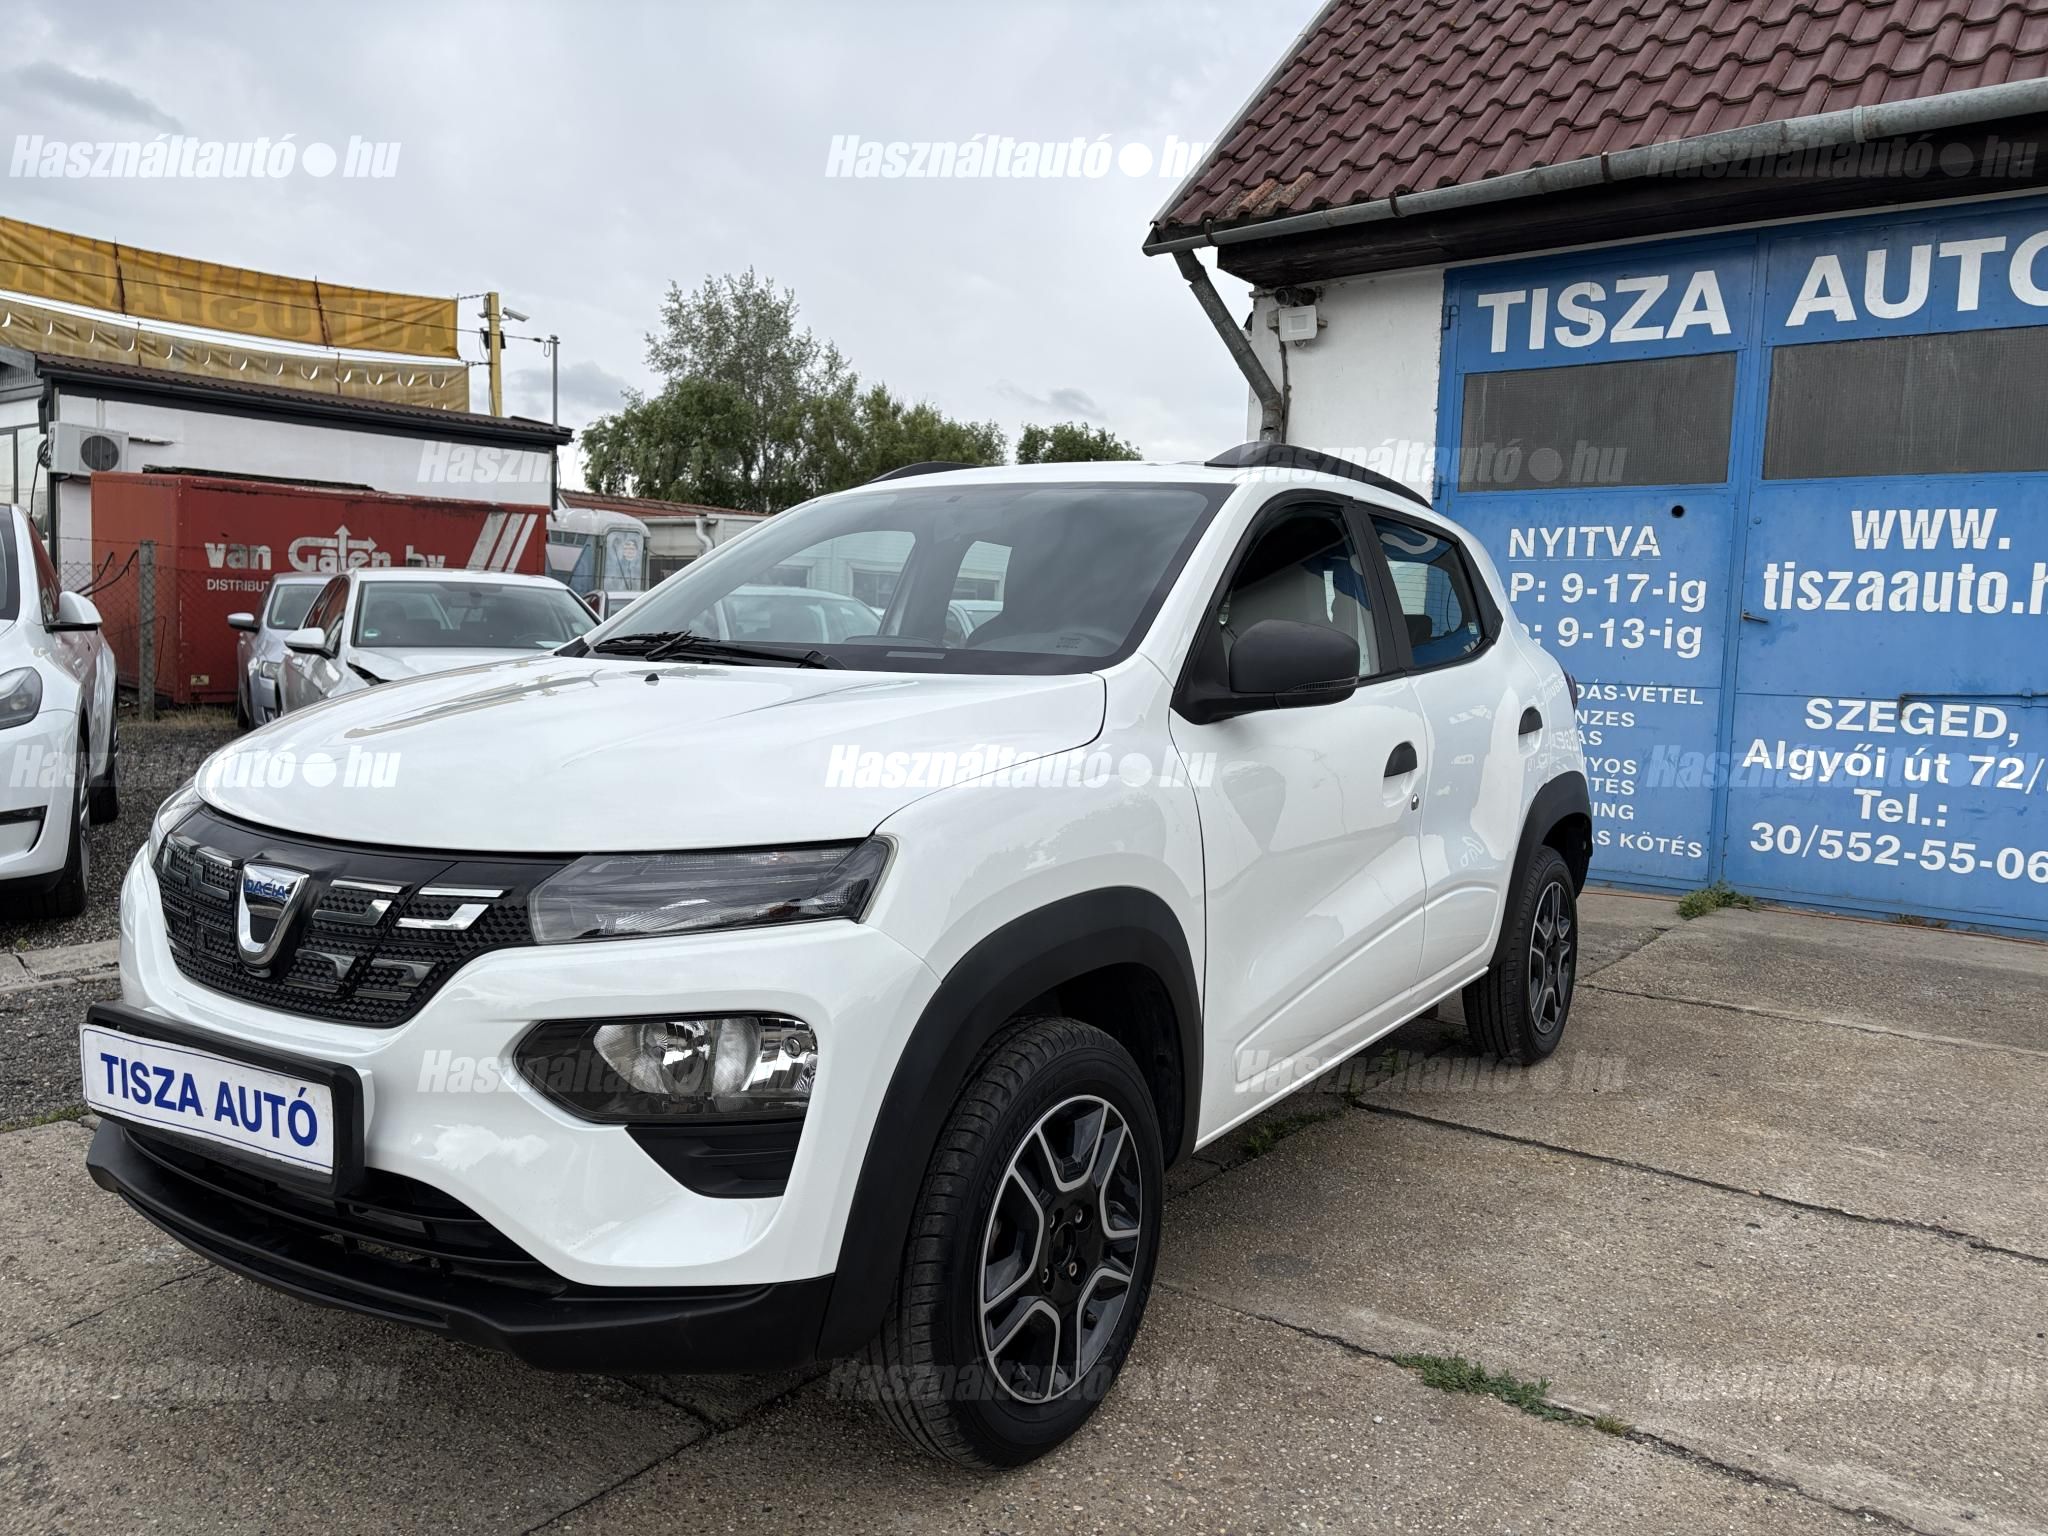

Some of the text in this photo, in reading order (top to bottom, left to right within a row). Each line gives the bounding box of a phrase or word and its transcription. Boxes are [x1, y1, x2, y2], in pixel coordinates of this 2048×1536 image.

[1477, 269, 1732, 353] TISZA
[1508, 525, 1662, 557] NYITVA
[1851, 508, 2011, 549] www.
[204, 542, 272, 571] van
[1561, 571, 1707, 613] 9-17-ig
[1557, 616, 1703, 659] 9-13-ig
[1804, 698, 2020, 748] SZEGED,
[1584, 756, 1637, 776] YOS
[1742, 738, 2048, 795] Algyői út 72/
[1853, 788, 1949, 829] Tel.:
[1619, 831, 1704, 859] KÖTÉS
[243, 878, 286, 900] DACIA
[100, 1052, 318, 1148] TISZA AUTÓ
